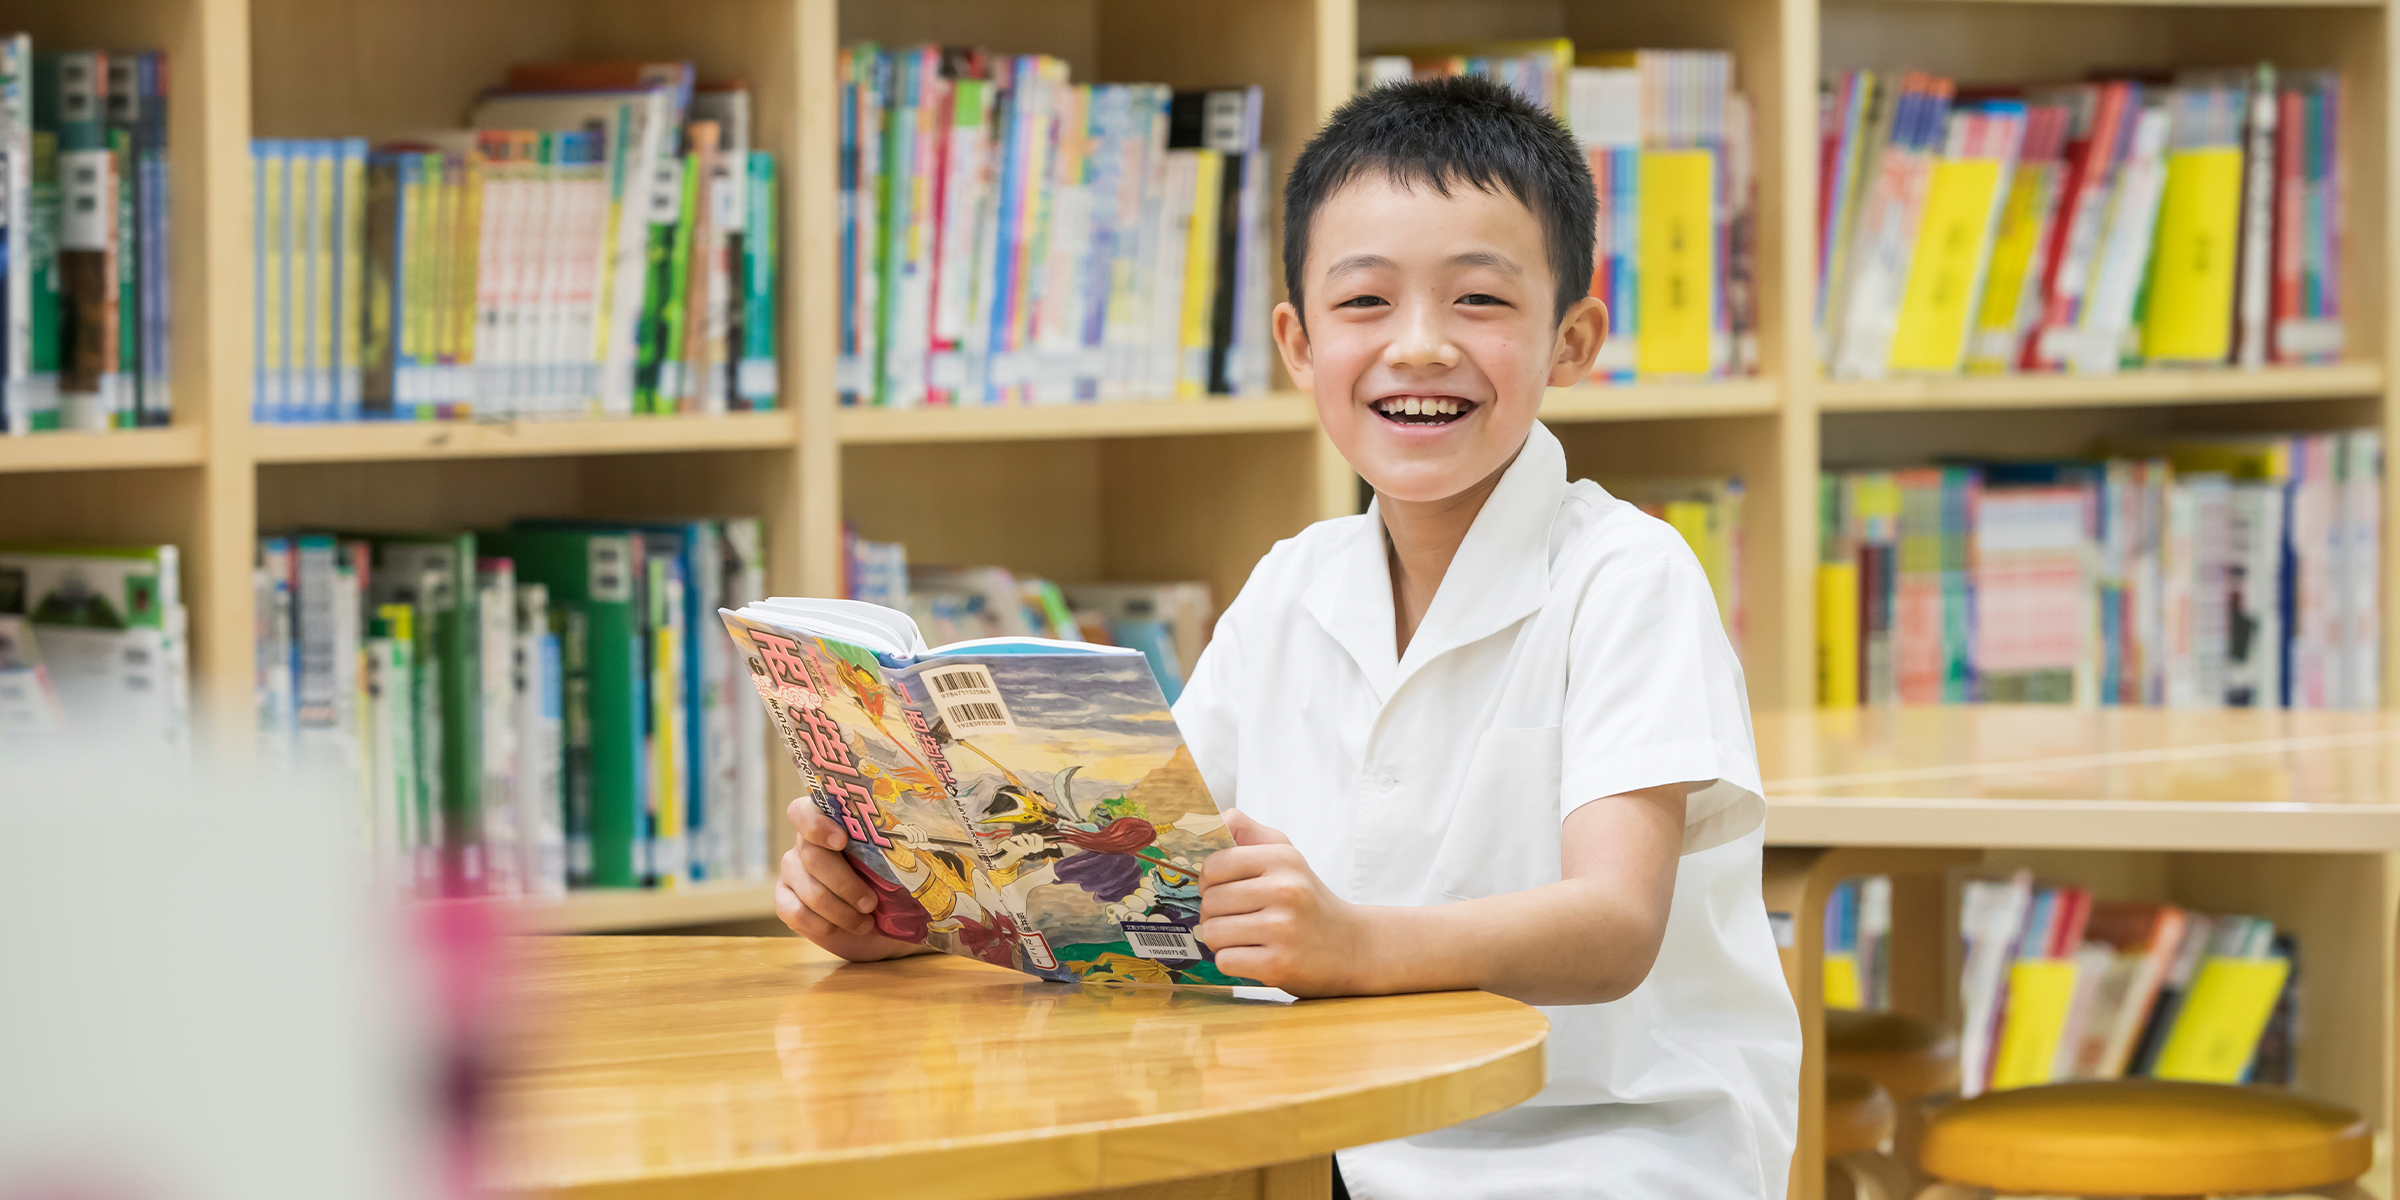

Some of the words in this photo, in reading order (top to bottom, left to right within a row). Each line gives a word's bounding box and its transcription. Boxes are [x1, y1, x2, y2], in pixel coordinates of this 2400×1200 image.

[748, 656, 764, 675] 6
[941, 690, 991, 698] 9784751525869
[957, 720, 1006, 729] 1928397013009
[748, 628, 894, 850] 西遊記
[902, 708, 957, 784] 西遊記
